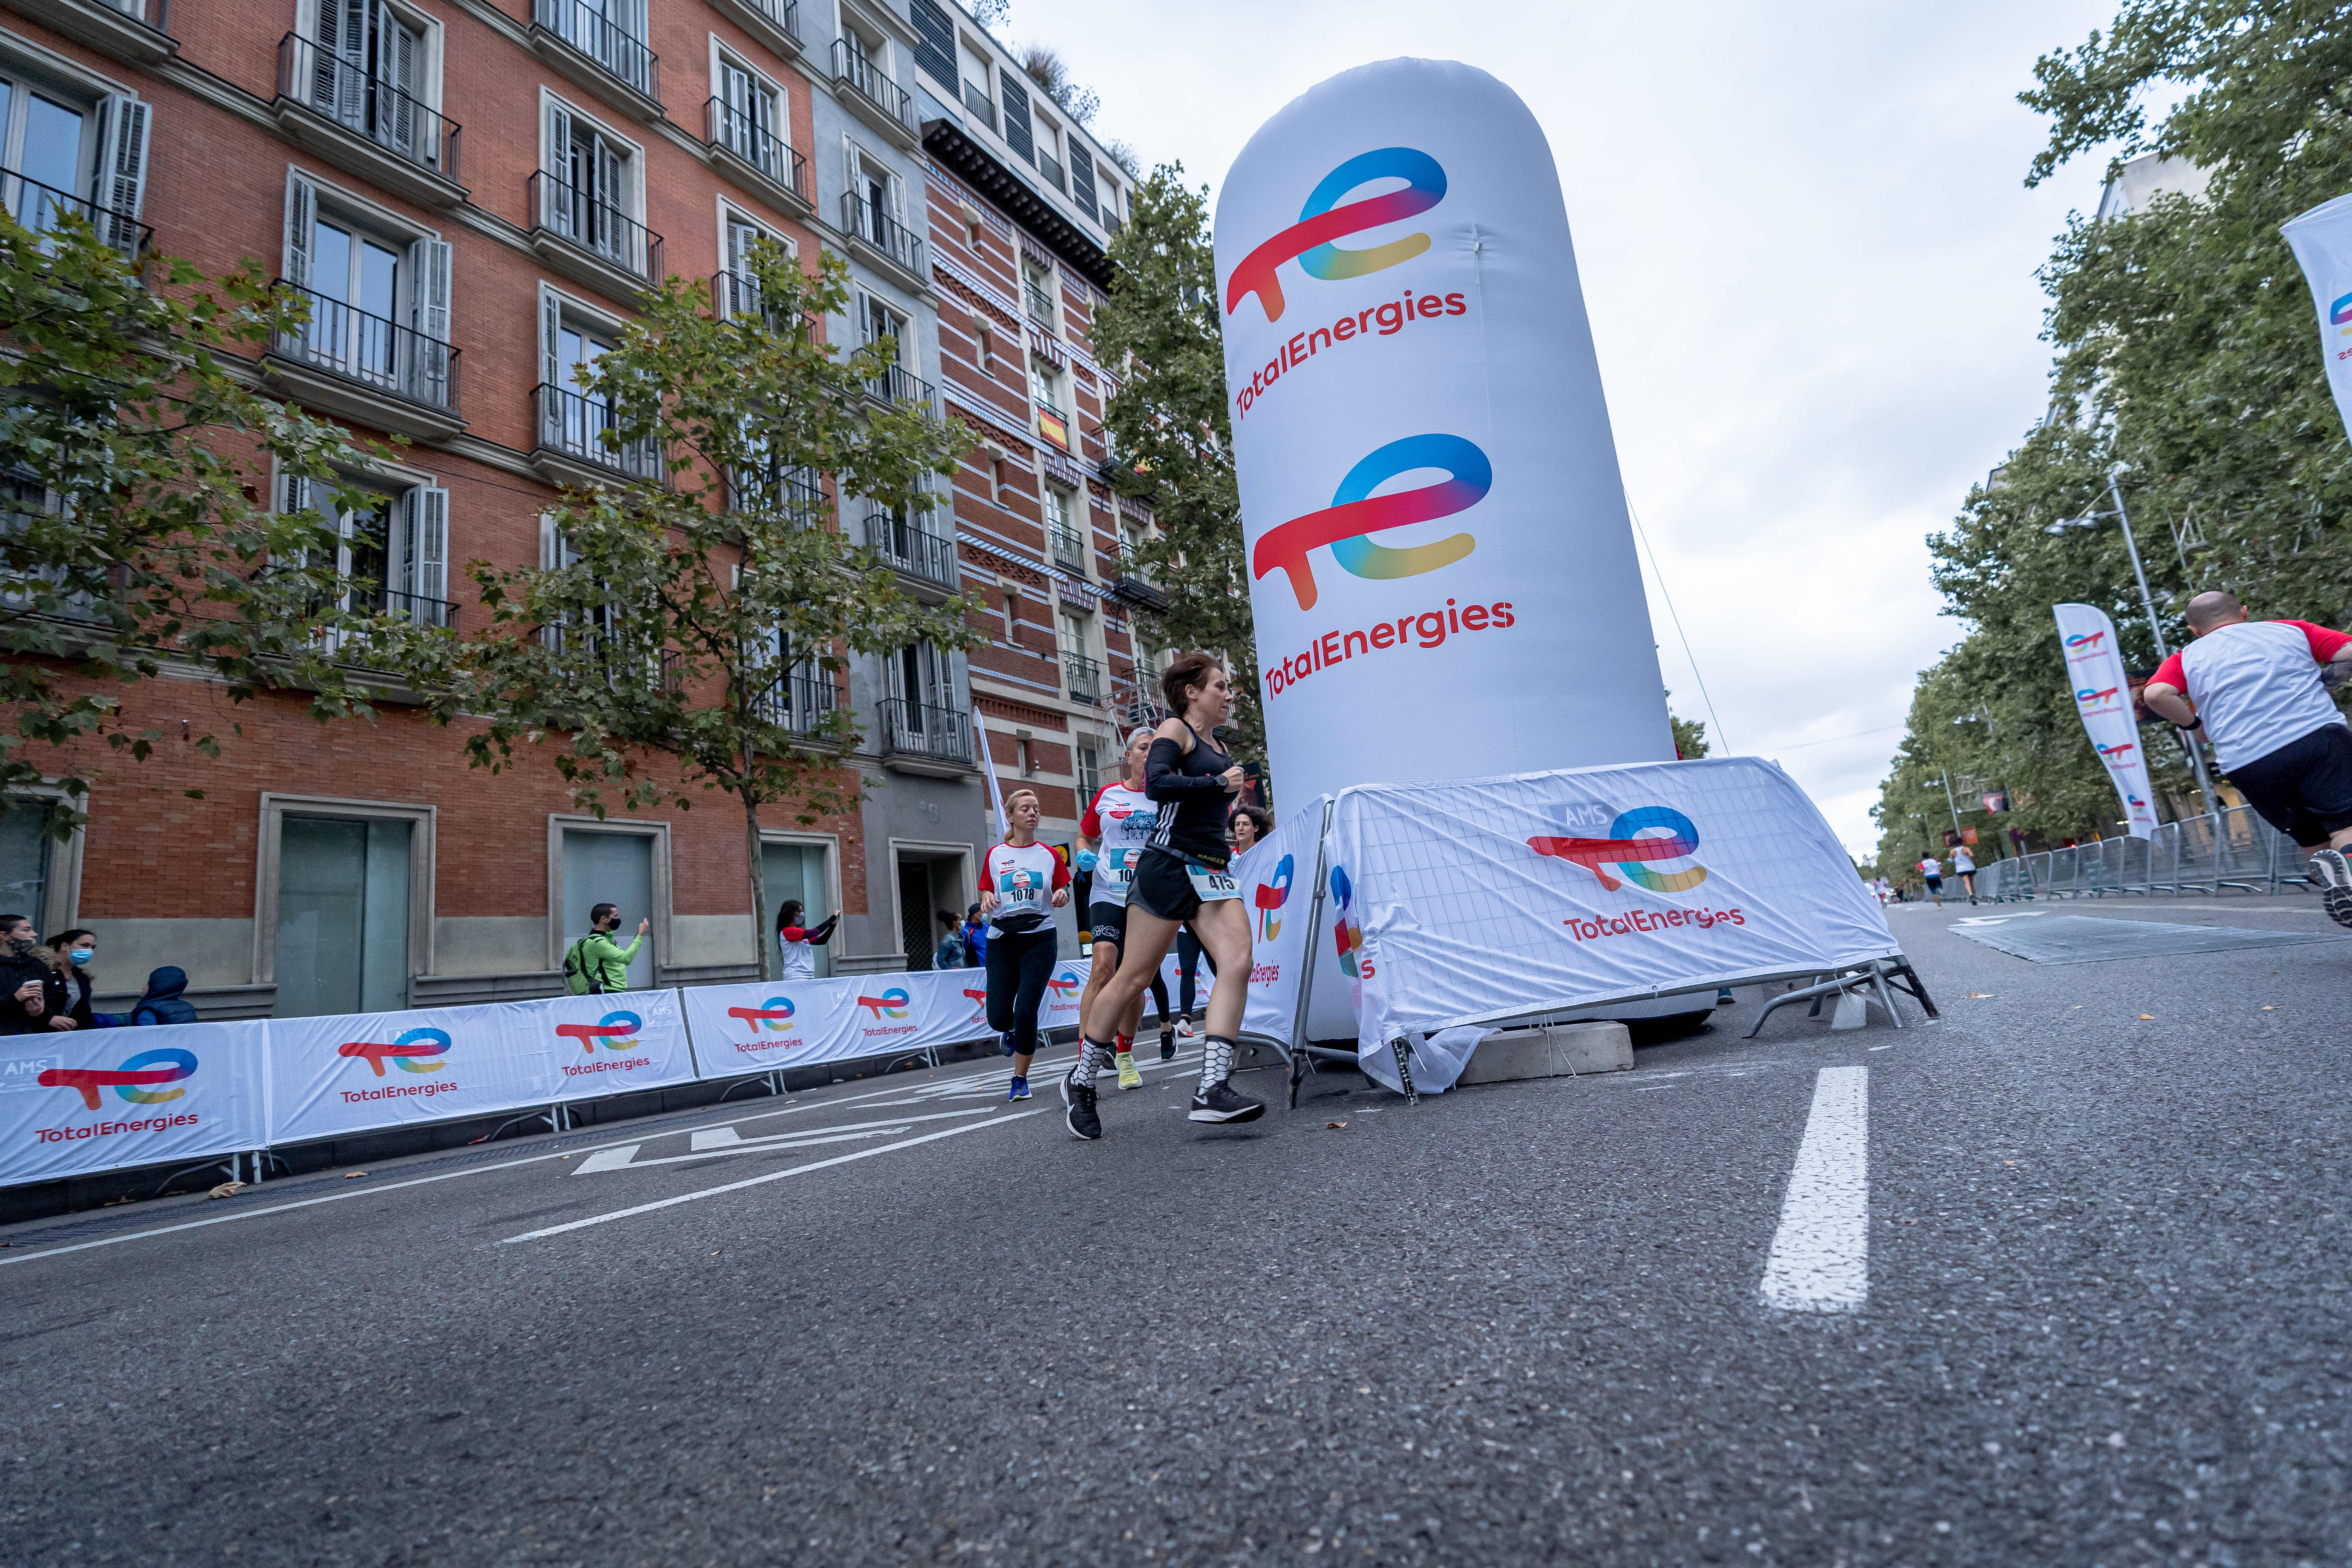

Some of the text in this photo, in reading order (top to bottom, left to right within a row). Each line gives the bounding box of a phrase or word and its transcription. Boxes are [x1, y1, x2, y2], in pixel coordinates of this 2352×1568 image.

[1237, 290, 1467, 421] TotalEnergies
[1266, 598, 1515, 701] TotalEnergies
[1566, 805, 1608, 827] AMS
[1118, 869, 1132, 882] 10
[1209, 875, 1235, 890] 475
[1011, 888, 1035, 902] 1078
[1249, 959, 1279, 988] alEnergies
[652, 1005, 672, 1016] AMS
[1050, 1002, 1080, 1011] TotalEnergi
[862, 1024, 918, 1036] TotalEnergies
[735, 1038, 803, 1053] TotalEnergies
[4, 1060, 47, 1076] AMS
[562, 1056, 650, 1076] TotalEnergies
[340, 1080, 458, 1103] TotalEnergies
[35, 1112, 198, 1144] TotalEnergies
